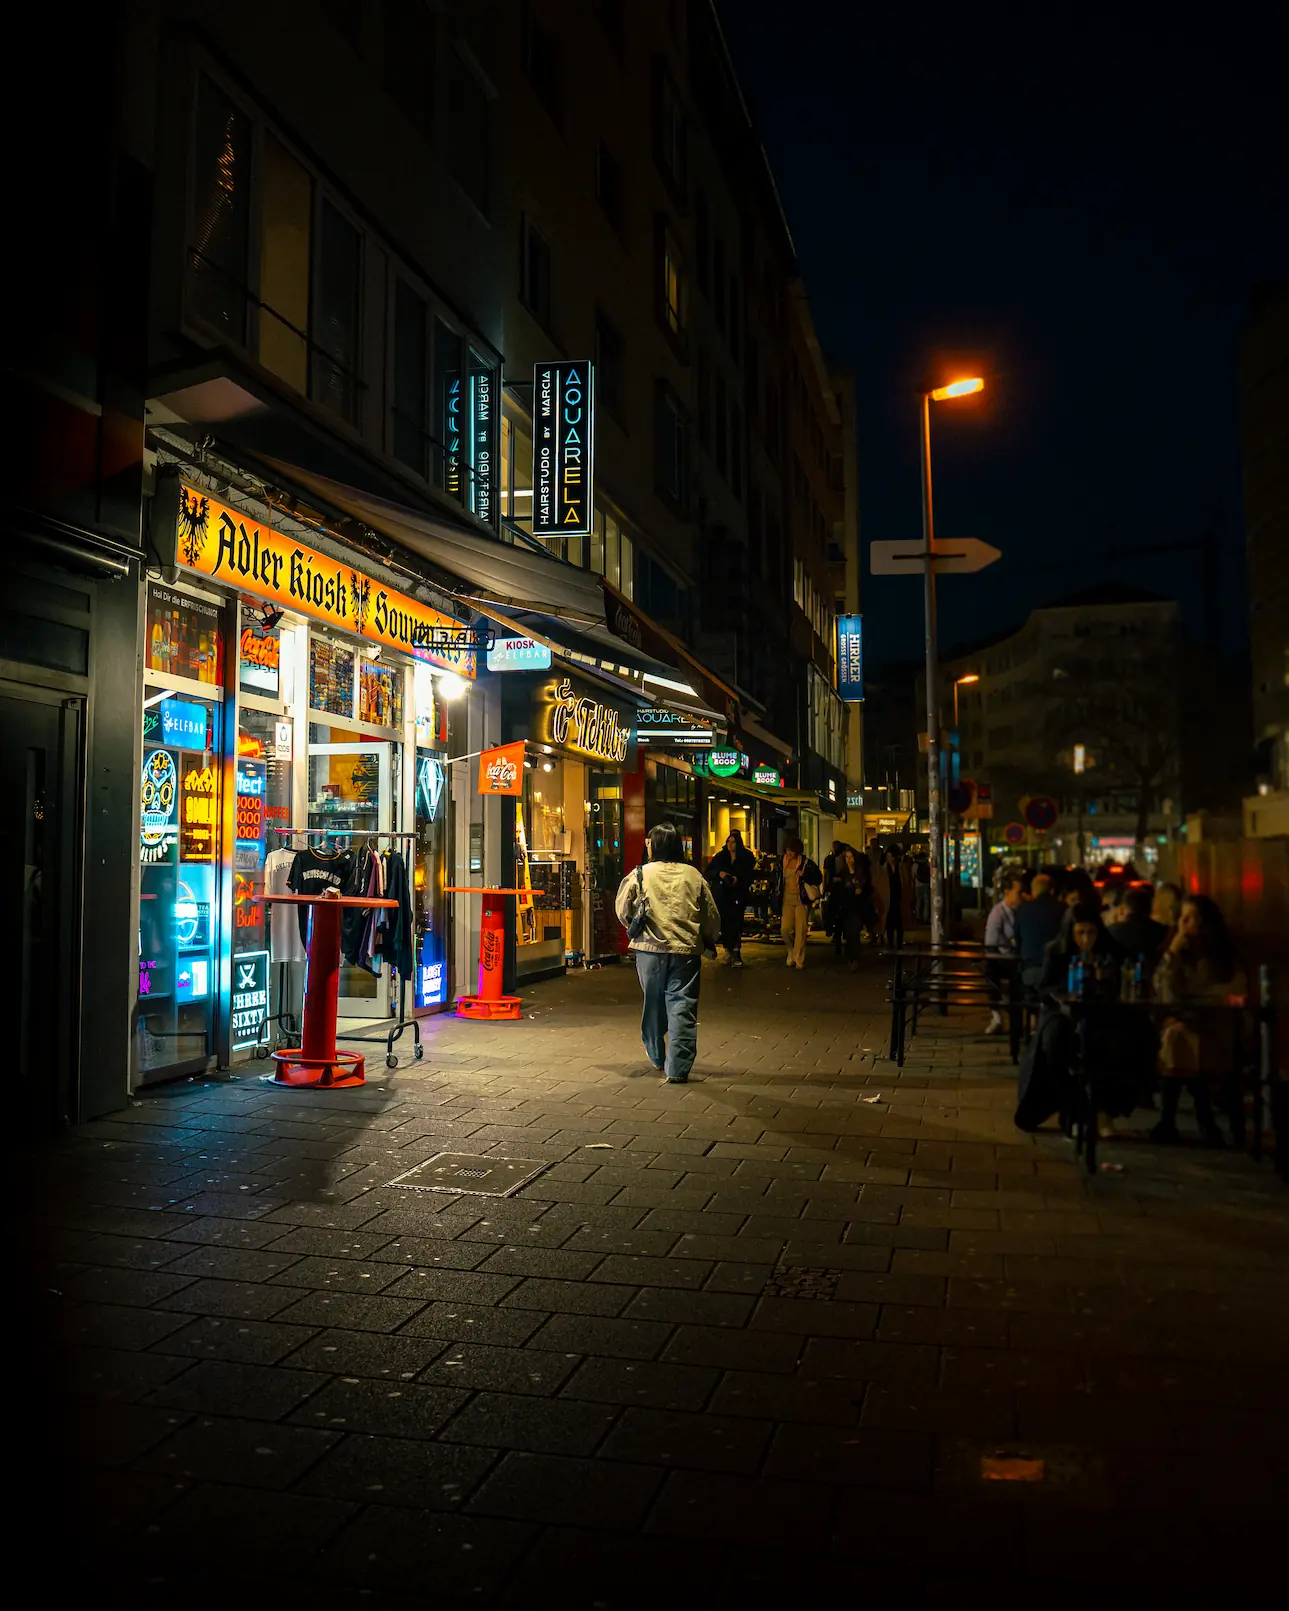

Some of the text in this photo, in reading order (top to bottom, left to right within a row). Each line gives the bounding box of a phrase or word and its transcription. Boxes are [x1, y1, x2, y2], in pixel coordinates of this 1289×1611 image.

[539, 370, 551, 525] HAIRSTUDIO BY MARCIA
[564, 368, 582, 524] AQUARELA
[211, 510, 284, 592] Adler
[289, 547, 347, 618] Kiosk
[152, 588, 163, 599] Hol
[163, 591, 172, 601] Dir
[171, 594, 181, 605] die
[505, 640, 535, 650] KIOSK
[849, 634, 861, 682] HIRMER
[575, 697, 631, 761] Tchibo
[713, 758, 736, 766] 2000
[236, 906, 257, 928] Bull
